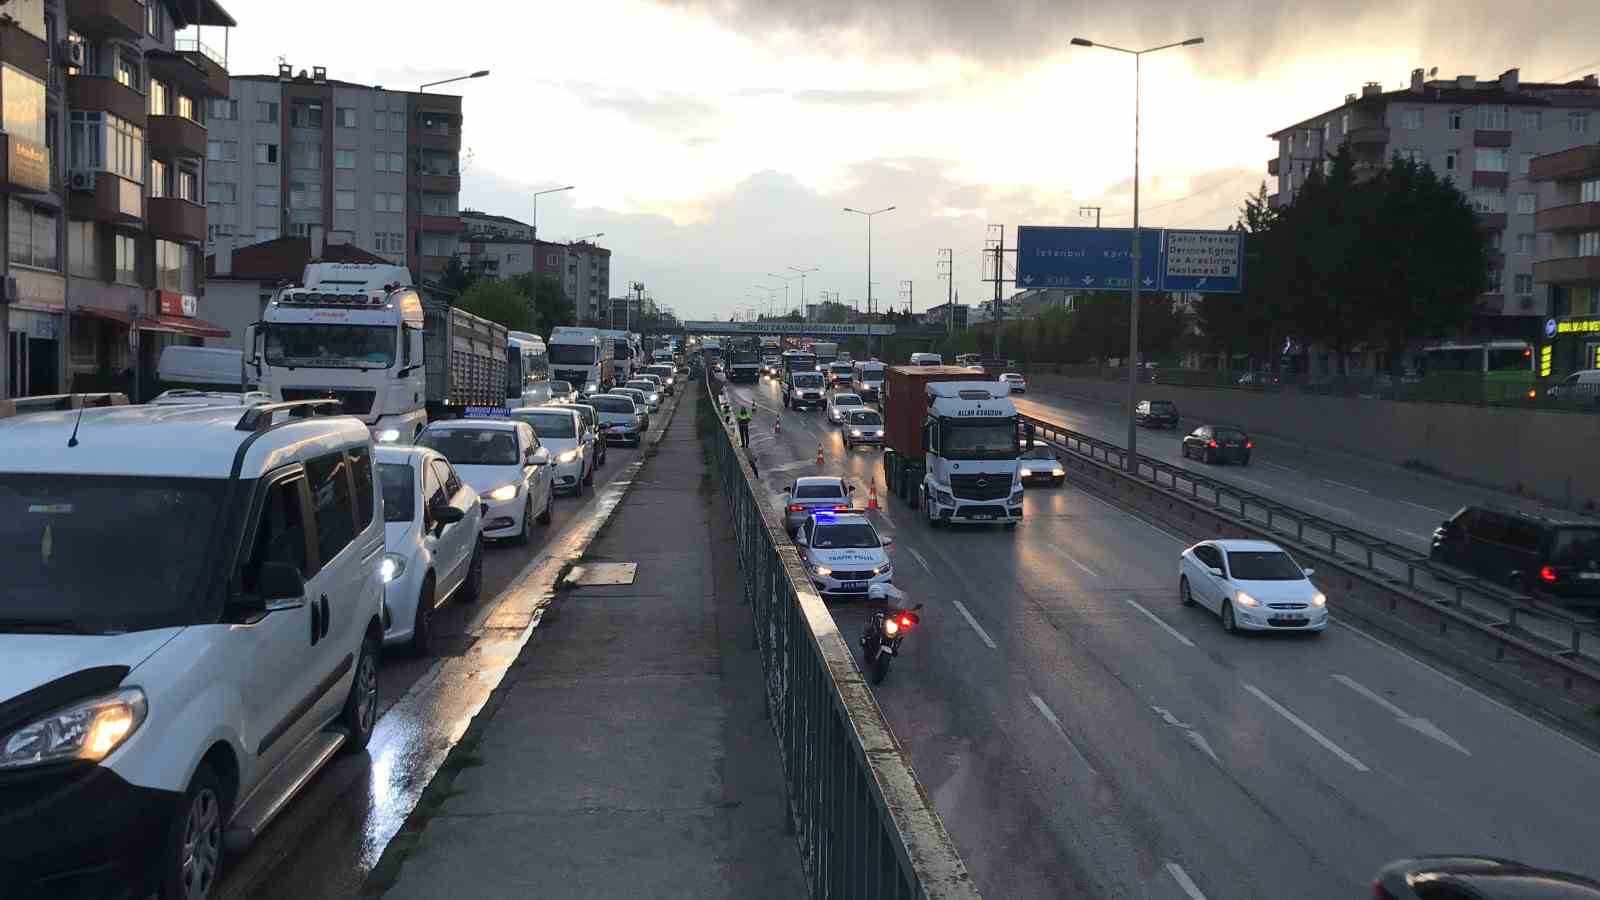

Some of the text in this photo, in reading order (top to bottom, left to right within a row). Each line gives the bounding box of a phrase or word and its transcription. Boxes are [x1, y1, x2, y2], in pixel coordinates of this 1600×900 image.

[1199, 235, 1236, 243] Merkez
[830, 325, 856, 333] ADAM
[1558, 321, 1588, 333] LVAR
[957, 409, 975, 417] ALLAH
